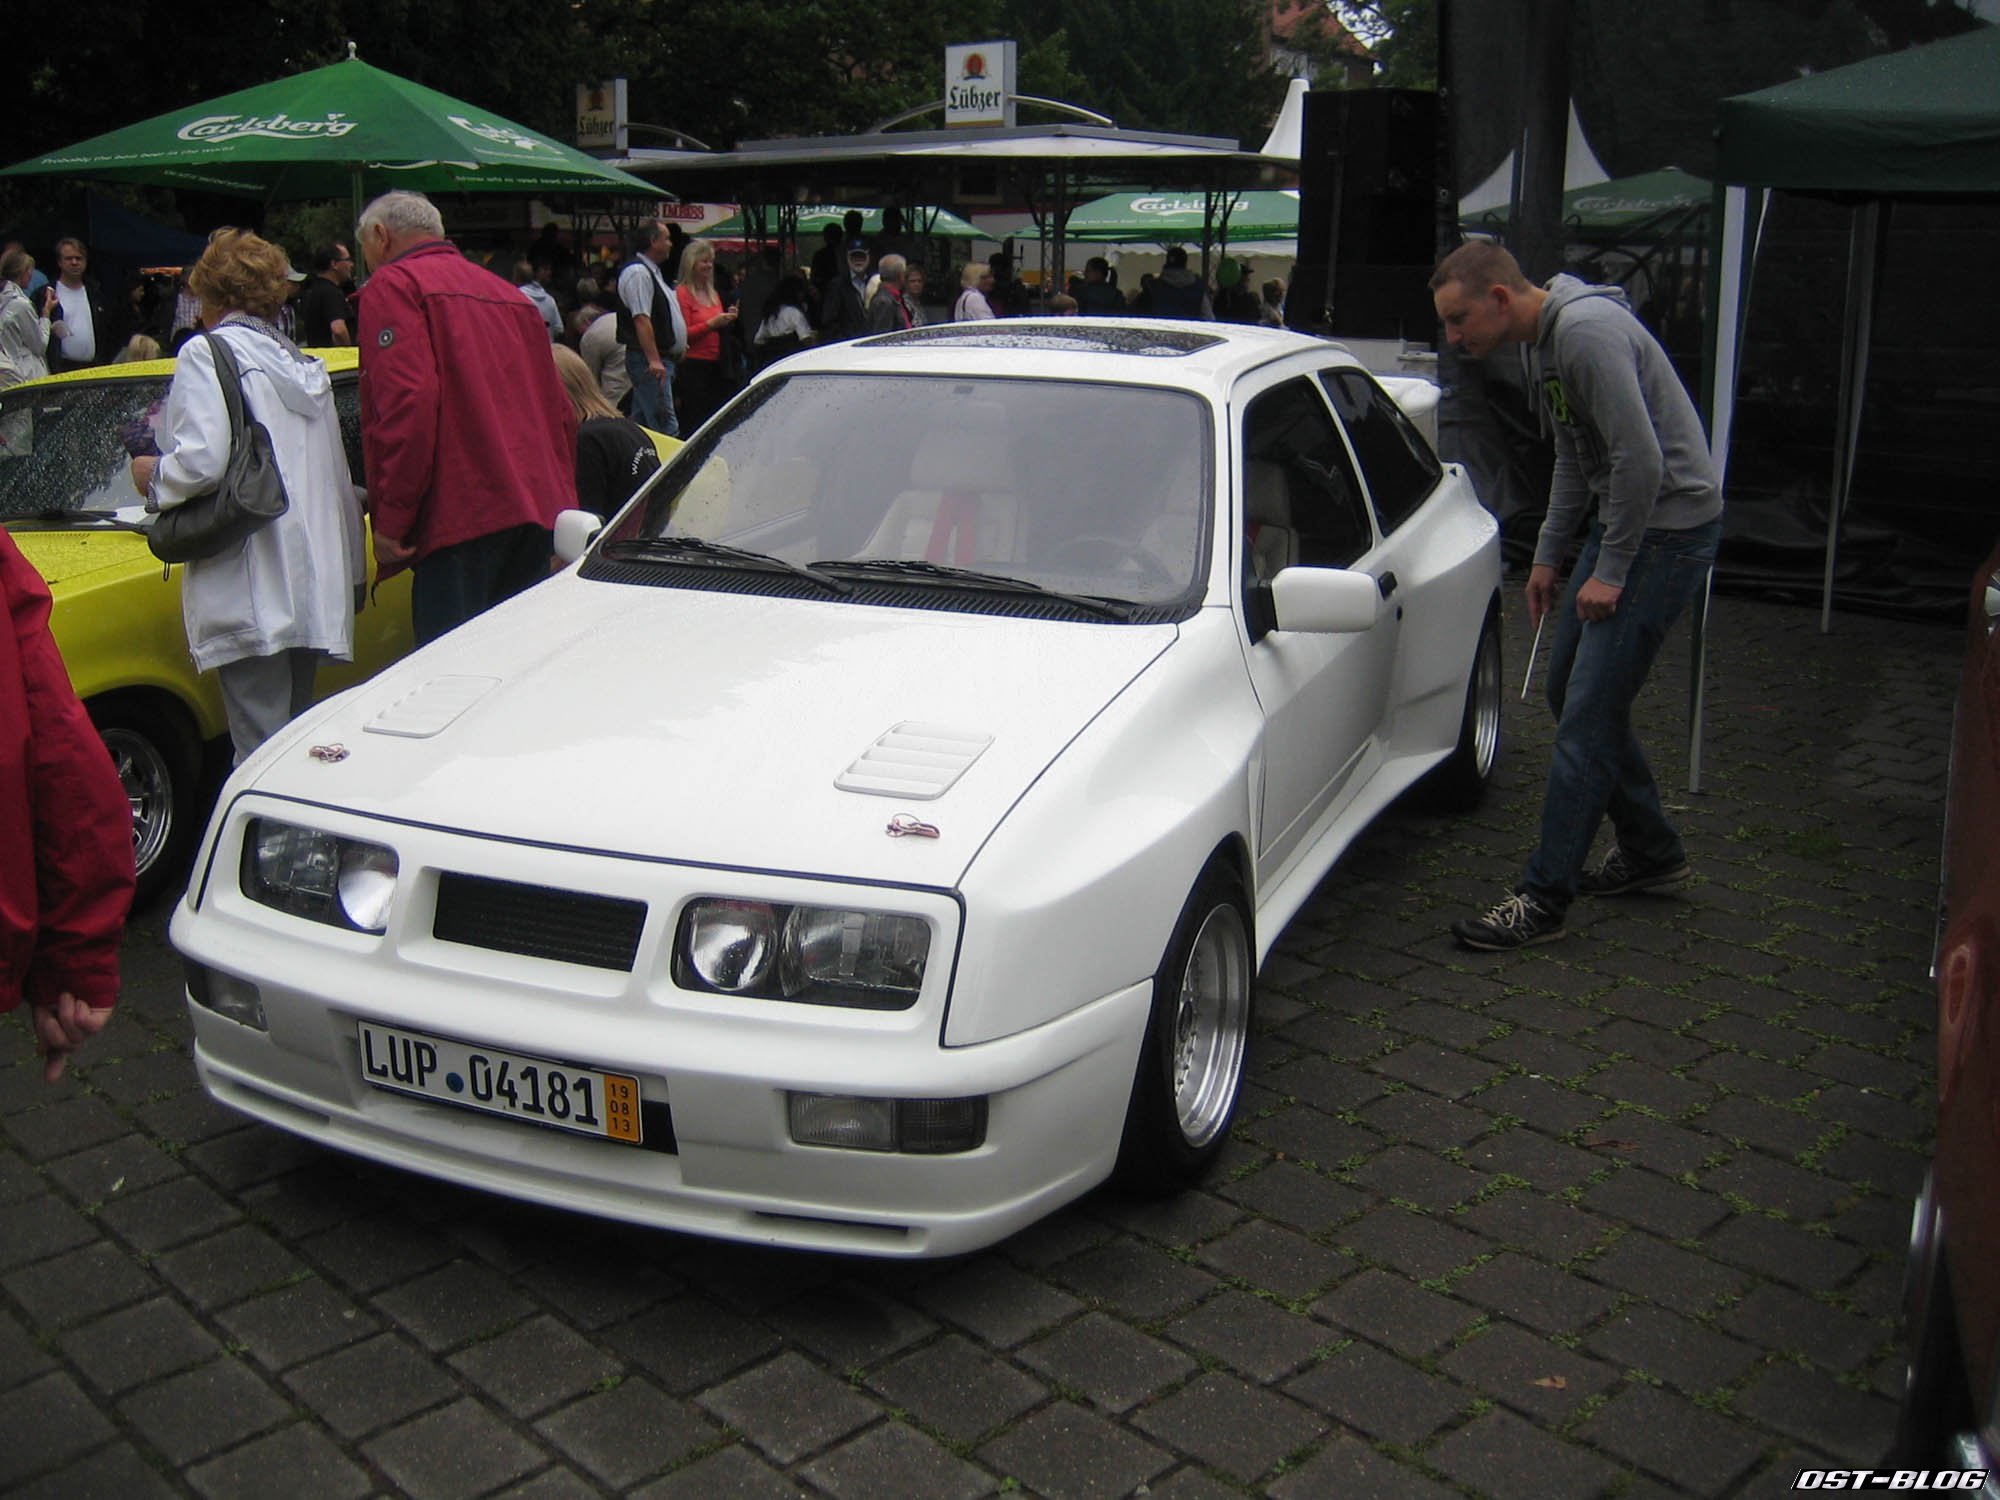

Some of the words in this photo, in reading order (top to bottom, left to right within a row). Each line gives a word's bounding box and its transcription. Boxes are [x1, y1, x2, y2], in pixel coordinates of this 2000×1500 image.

[948, 85, 1001, 112] Lübzer
[178, 112, 359, 143] Carlsberg
[1130, 196, 1249, 216] Carlsbg
[363, 1028, 437, 1088] LUP
[468, 1053, 599, 1126] 04181
[611, 1082, 629, 1098] 19
[610, 1100, 629, 1115] 08
[612, 1117, 630, 1132] 13
